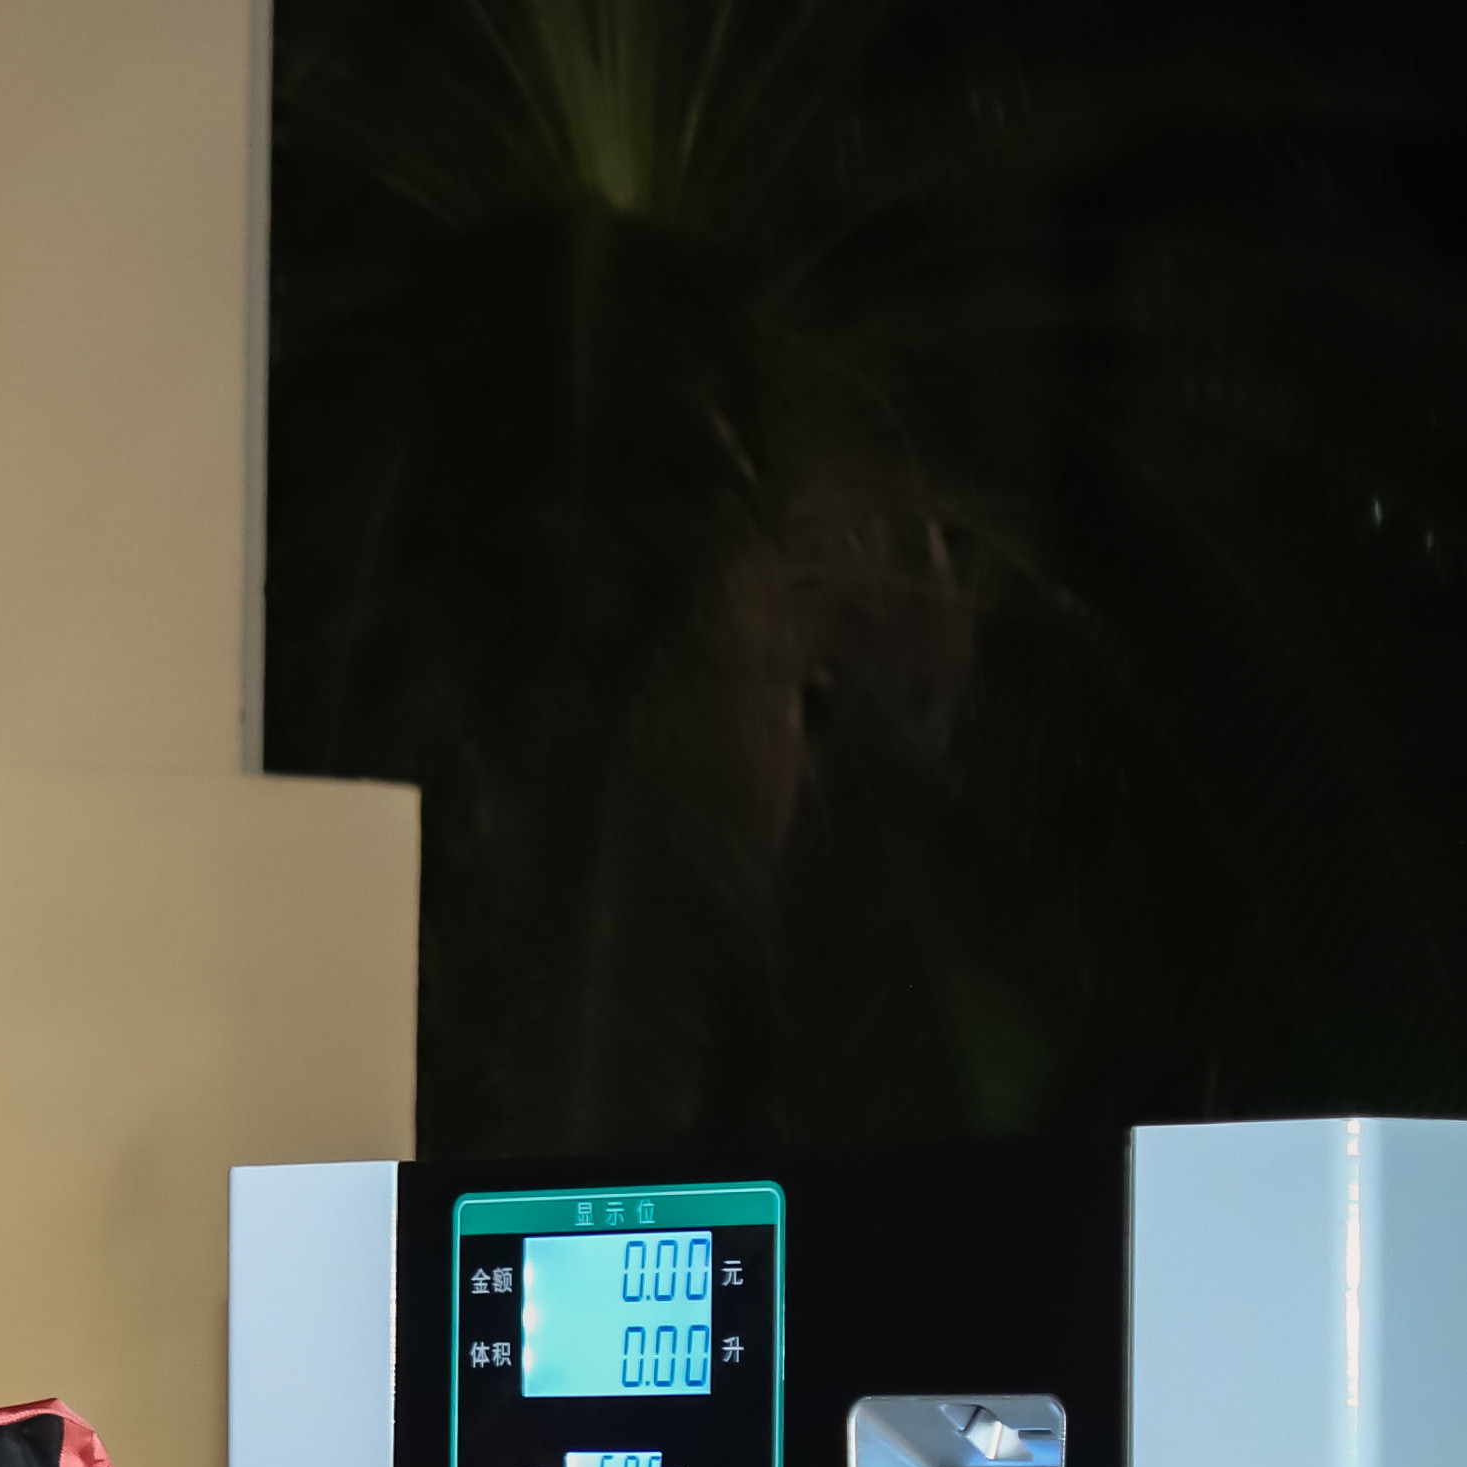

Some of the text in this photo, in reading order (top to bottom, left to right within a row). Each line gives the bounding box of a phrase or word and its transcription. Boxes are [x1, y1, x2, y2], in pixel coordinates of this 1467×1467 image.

[574, 1200, 656, 1226] 显示位
[470, 1238, 744, 1302] 金额 0.00 元
[470, 1324, 744, 1387] 体积 0.00 升
